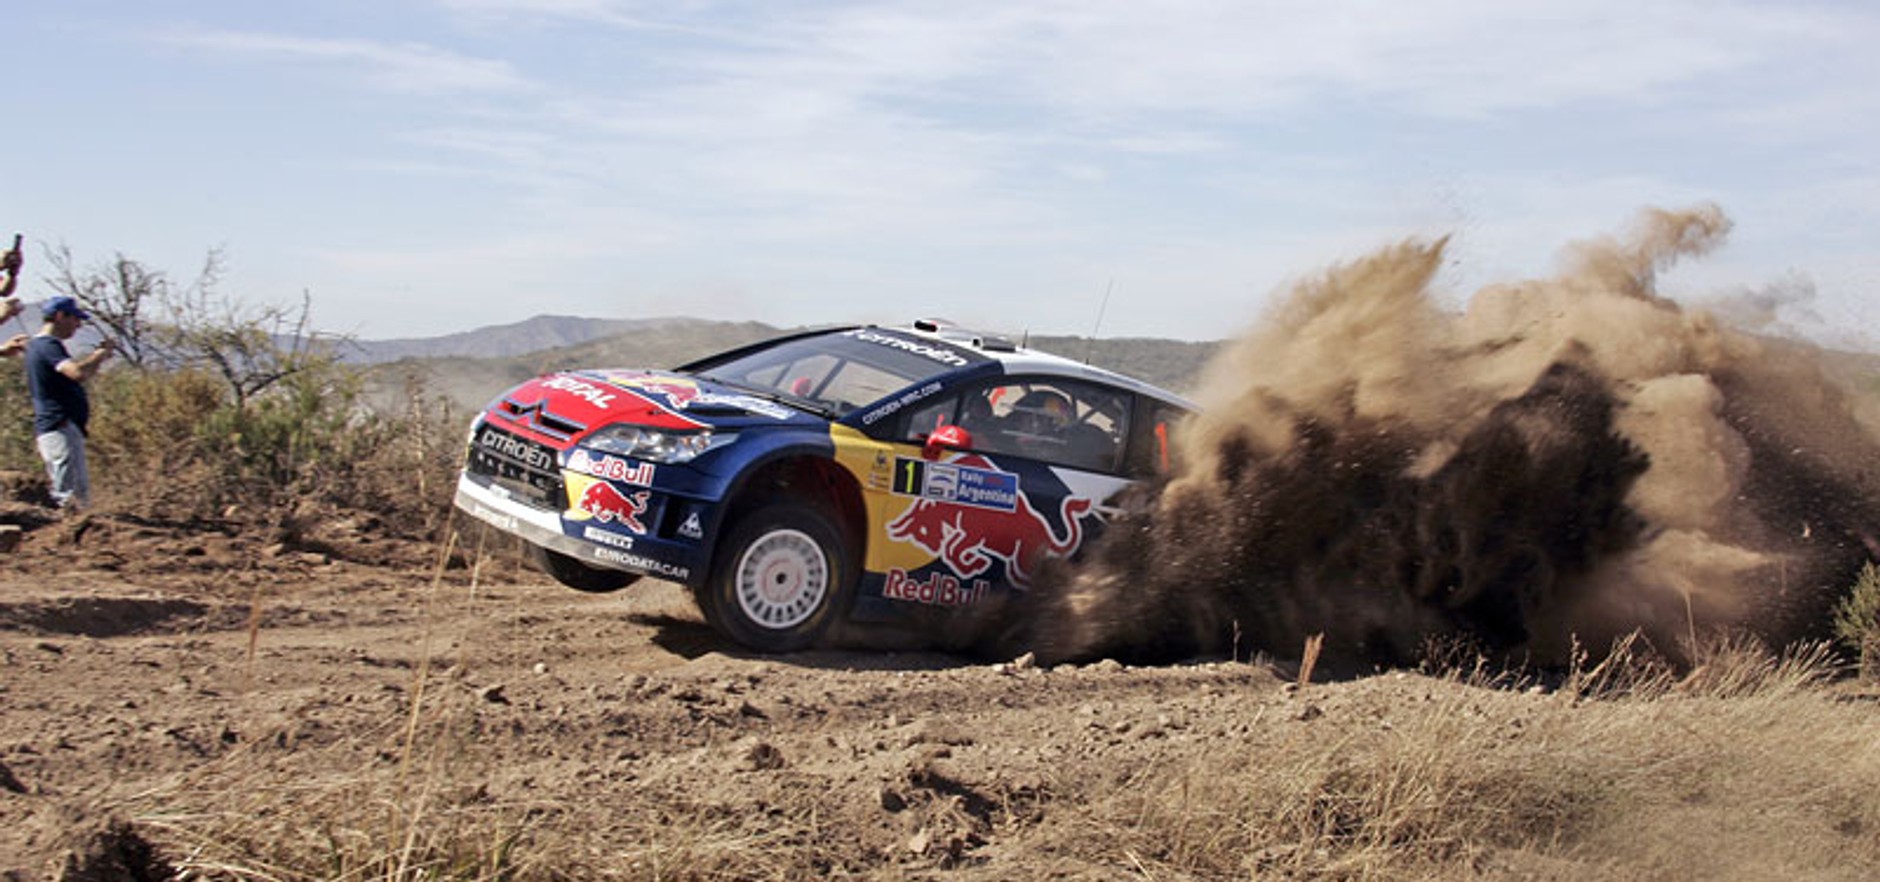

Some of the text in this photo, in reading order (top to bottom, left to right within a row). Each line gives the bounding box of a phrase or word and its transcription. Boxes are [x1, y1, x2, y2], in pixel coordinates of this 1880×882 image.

[541, 377, 616, 409] TOTAL
[566, 449, 656, 487] Red Bull
[905, 461, 915, 493] 1
[960, 470, 983, 486] Rally
[958, 483, 1014, 505] Argentina
[594, 547, 690, 579] EURODATACAR
[883, 567, 990, 606] Red Bull
